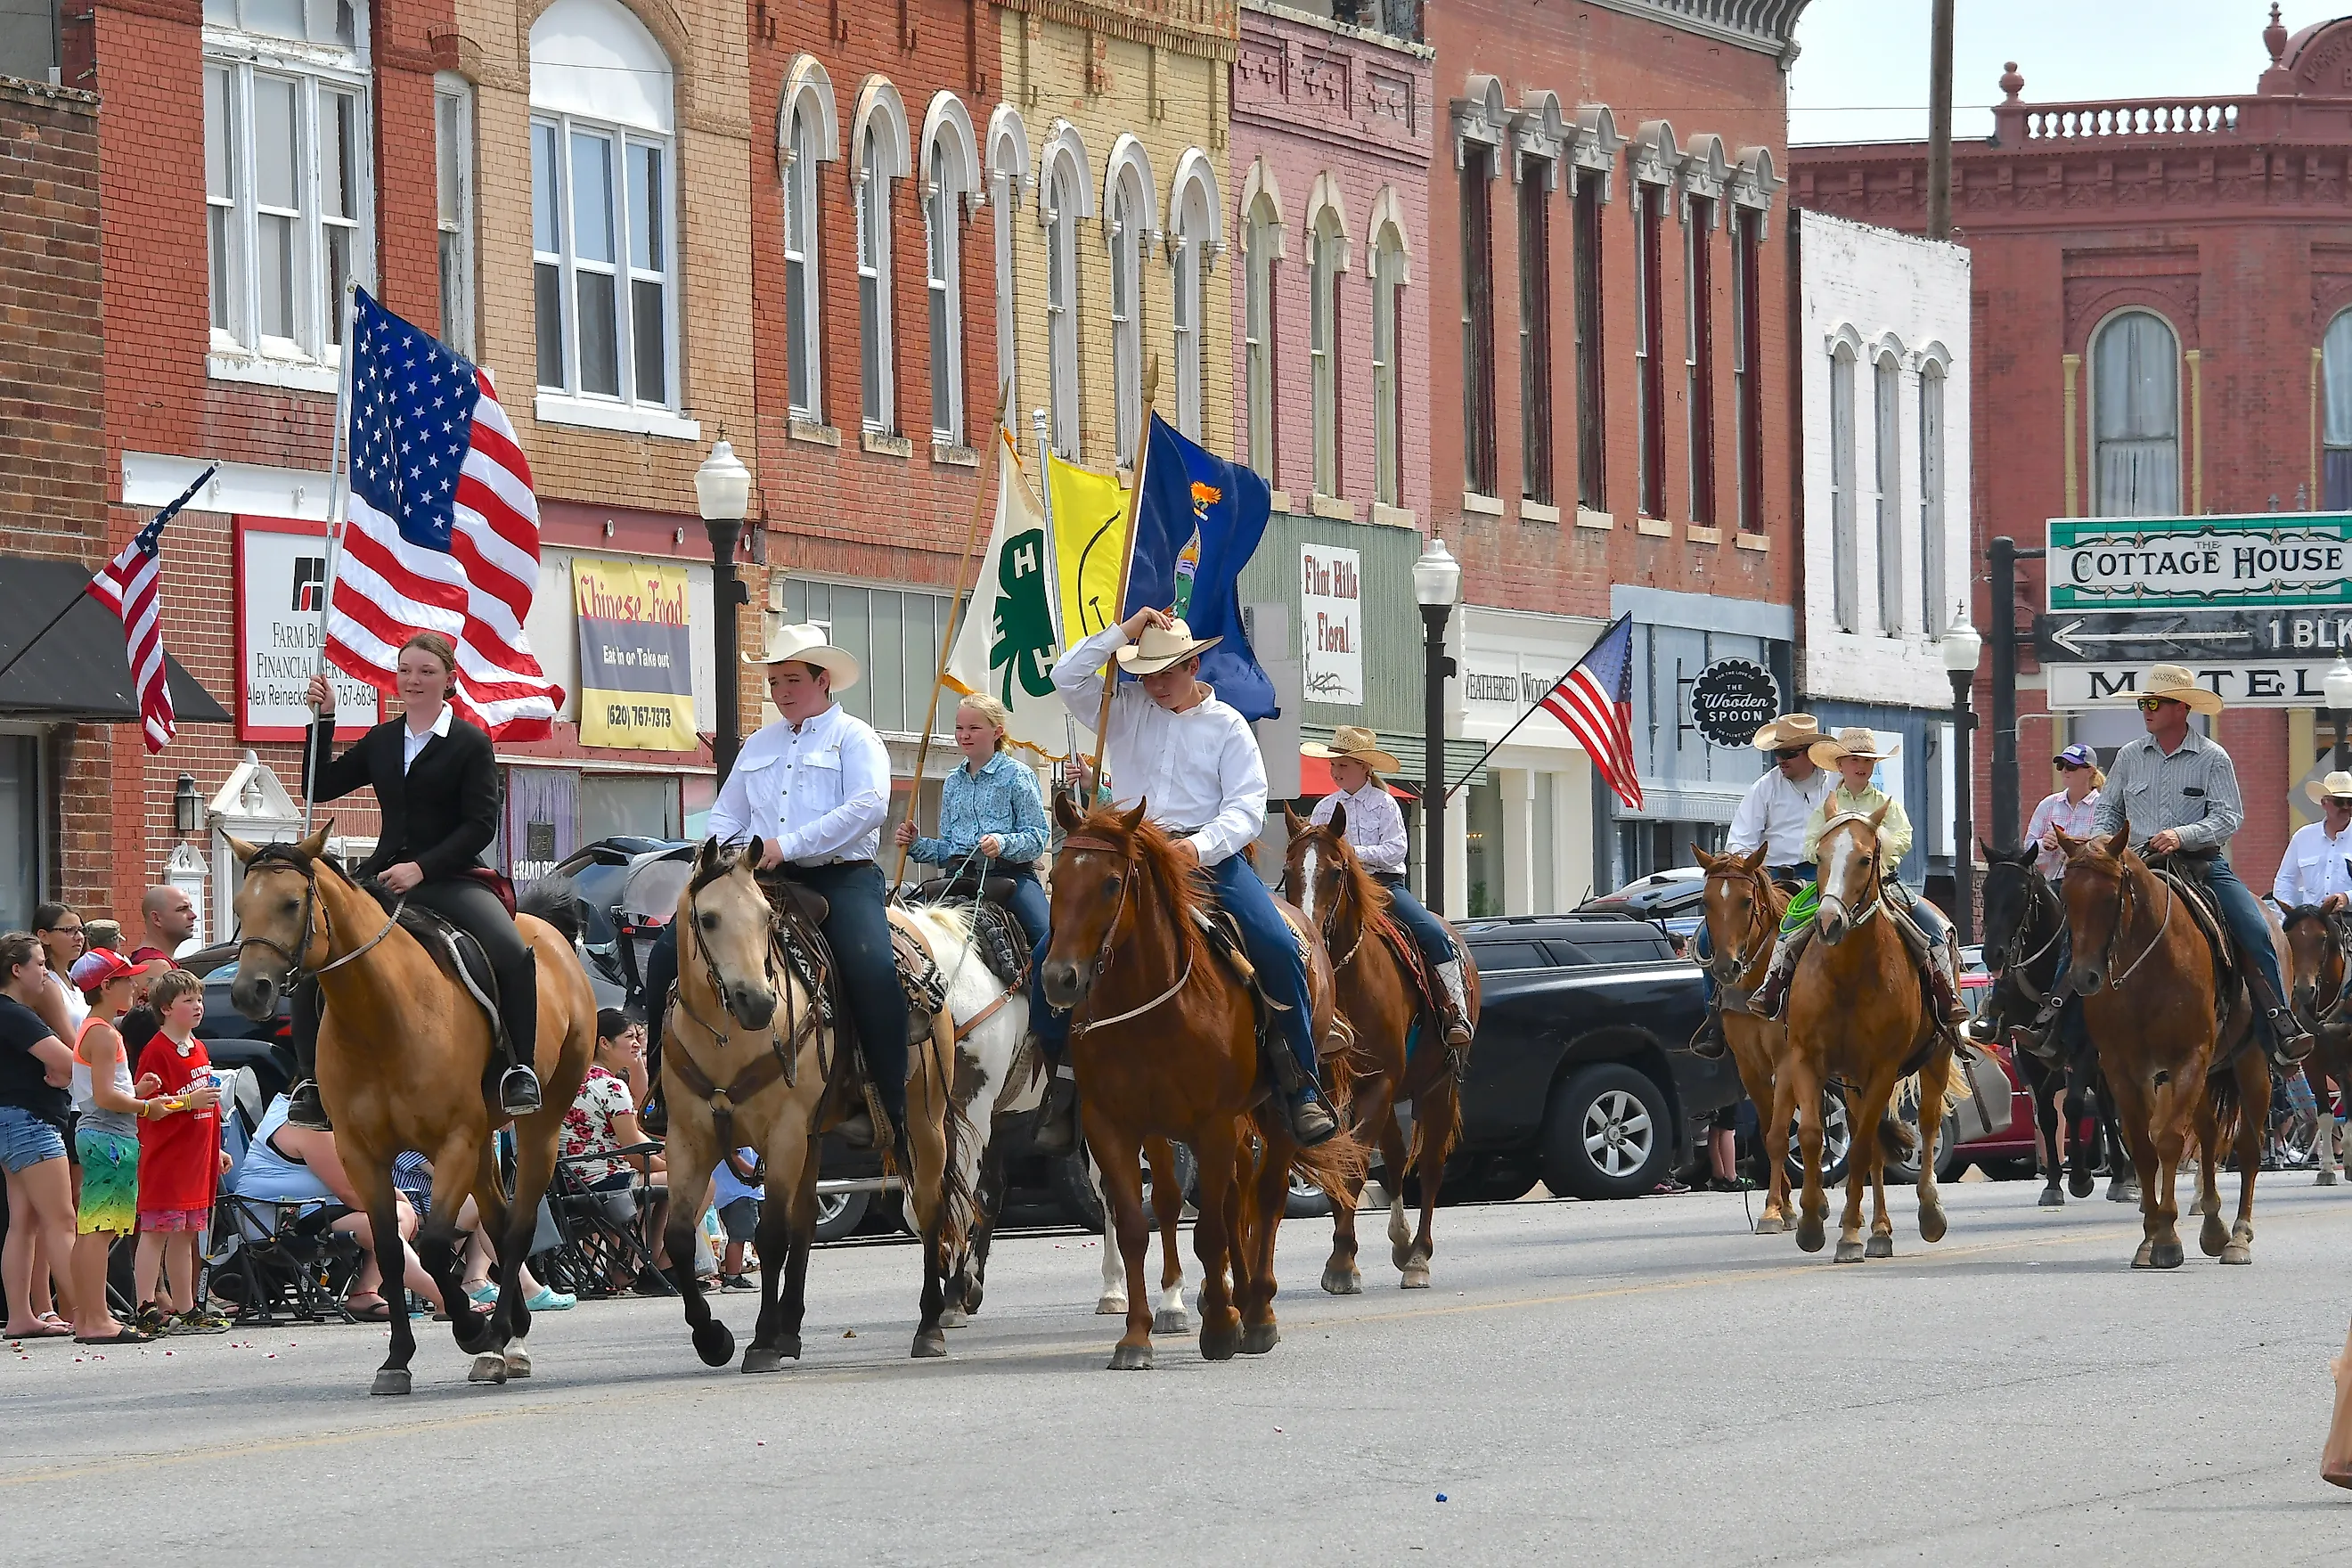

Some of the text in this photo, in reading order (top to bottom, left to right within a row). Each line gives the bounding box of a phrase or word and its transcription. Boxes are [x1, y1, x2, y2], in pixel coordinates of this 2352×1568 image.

[2194, 541, 2222, 550] THE
[1304, 554, 1358, 600] Flint Hills
[2070, 546, 2343, 584] COTTAGE HOUSE
[580, 574, 684, 627] Chinese Food
[272, 622, 304, 649] FARM
[1317, 611, 1350, 654] Floral
[2268, 619, 2280, 649] 1
[603, 644, 670, 669] Eat in or Take out
[247, 682, 266, 706] Alex
[337, 684, 377, 706] 767-6834
[2087, 668, 2325, 699] MTEL
[1701, 692, 1768, 709] Wooden
[607, 704, 671, 731] (620) 767-7373
[1709, 711, 1762, 722] SPOON
